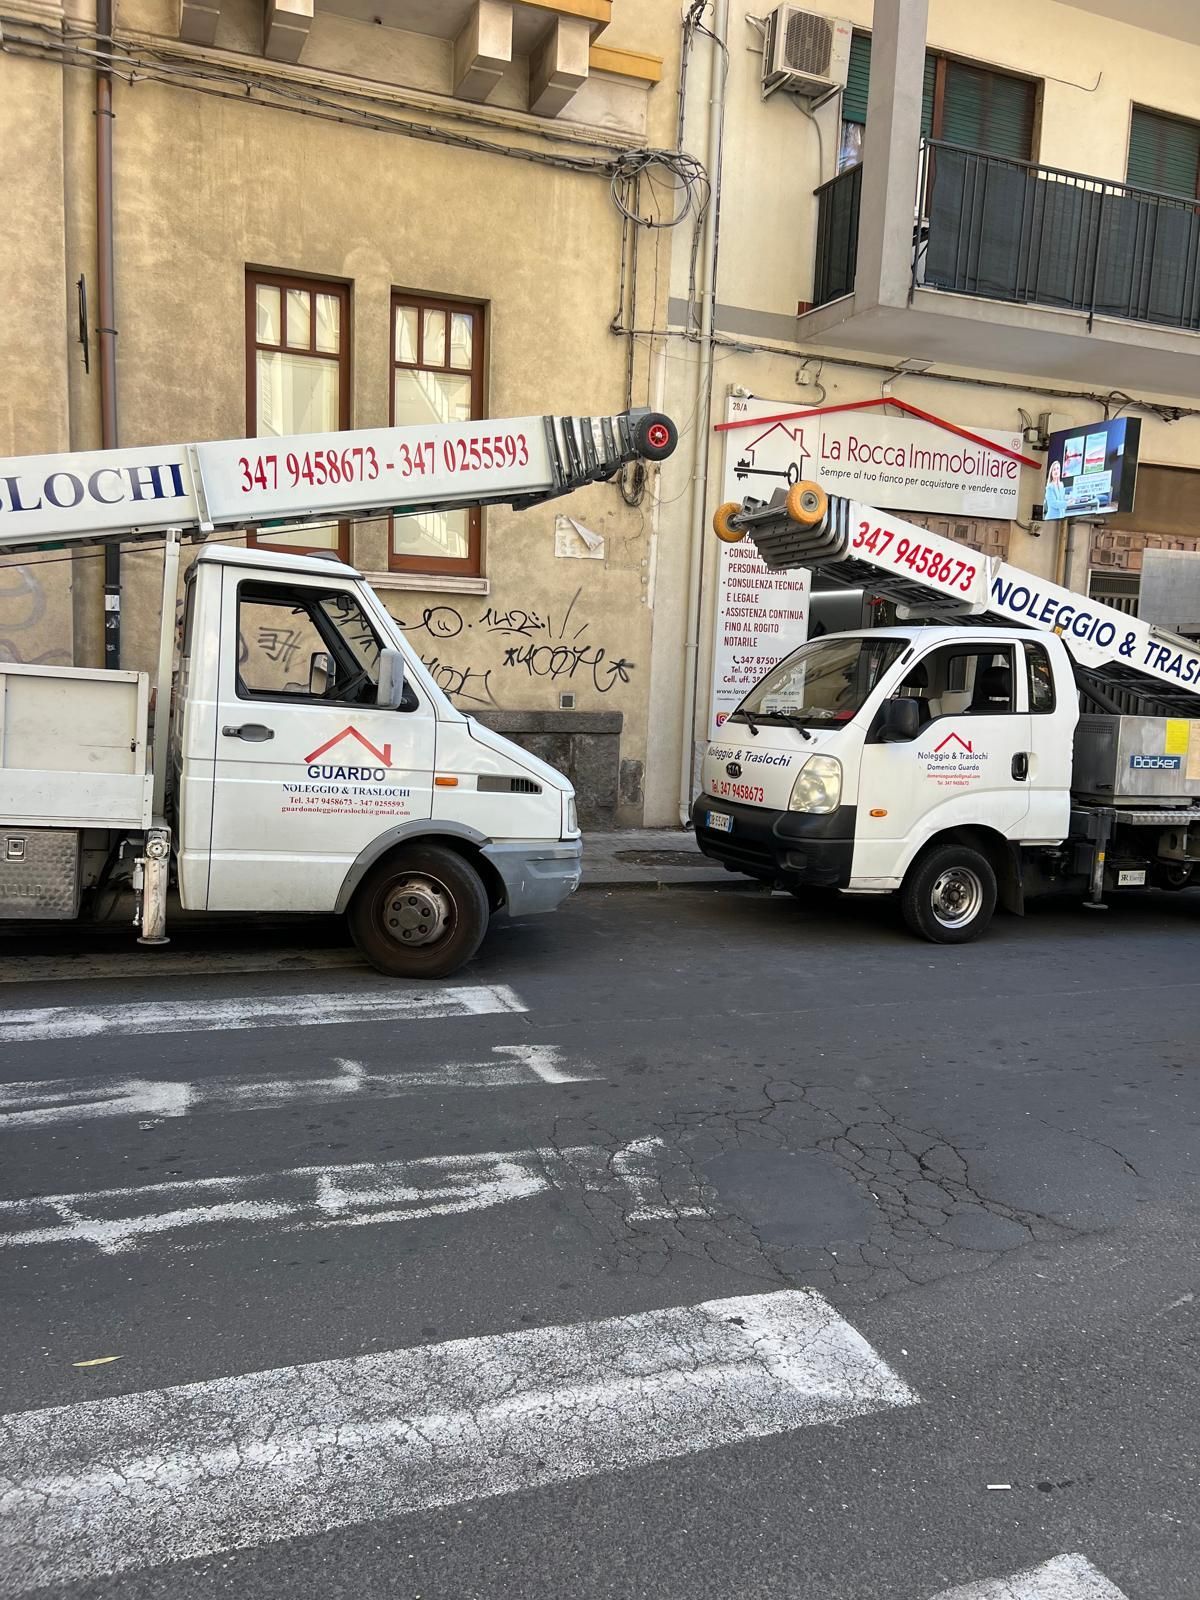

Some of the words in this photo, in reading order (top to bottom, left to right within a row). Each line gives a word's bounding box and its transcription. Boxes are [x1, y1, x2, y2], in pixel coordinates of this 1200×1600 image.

[732, 402, 748, 412] 28/A
[821, 432, 841, 461] La
[238, 454, 278, 493] 347
[286, 446, 380, 489] 9458673
[399, 441, 436, 478] 347
[443, 433, 530, 473] 0255593
[820, 466, 852, 478] Sempre
[853, 470, 862, 479] al
[864, 472, 877, 481] tuo
[880, 472, 904, 484] fianco
[904, 477, 918, 487] per
[920, 479, 960, 490] acquistare
[968, 484, 998, 494] vendere
[1000, 487, 1017, 496] casa
[0, 463, 190, 513] LOCHI
[852, 521, 895, 558] 347
[892, 538, 977, 592] 9458673
[727, 578, 773, 590] CONSULENZA
[774, 581, 804, 592] TECNICA
[726, 592, 732, 602] E
[733, 593, 759, 604] LEGALE
[726, 608, 767, 619] ASSISTENZA
[768, 609, 804, 620] CONTINUA
[991, 577, 1117, 648] NOLEGGIO
[1119, 631, 1137, 658] &
[724, 622, 741, 632] FINO
[743, 622, 752, 633] AL
[753, 623, 779, 633] ROGITO
[723, 636, 758, 648] NOTARILE
[740, 656, 754, 664] 347
[731, 666, 742, 674] Tel.
[744, 666, 757, 674] 095
[735, 749, 743, 760] &
[744, 751, 792, 767] Traslochi
[917, 751, 950, 761] Noleggio
[952, 752, 958, 760] &
[960, 752, 988, 760] Traslochi
[1133, 756, 1178, 769] Böcker
[307, 765, 386, 782] GUARDO
[927, 763, 957, 771] Domenico
[958, 763, 980, 771] Guardo
[282, 783, 339, 796] NOLEGGIO
[341, 784, 350, 795] &
[351, 786, 411, 798] TRASLOCHI
[711, 779, 720, 793] Tel.
[720, 781, 731, 796] 347
[732, 783, 765, 803] 9458673
[289, 796, 304, 804] Tel.
[305, 797, 320, 805] 347
[321, 798, 354, 807] 9458673
[359, 799, 373, 807] 347
[374, 800, 405, 808] 0255593
